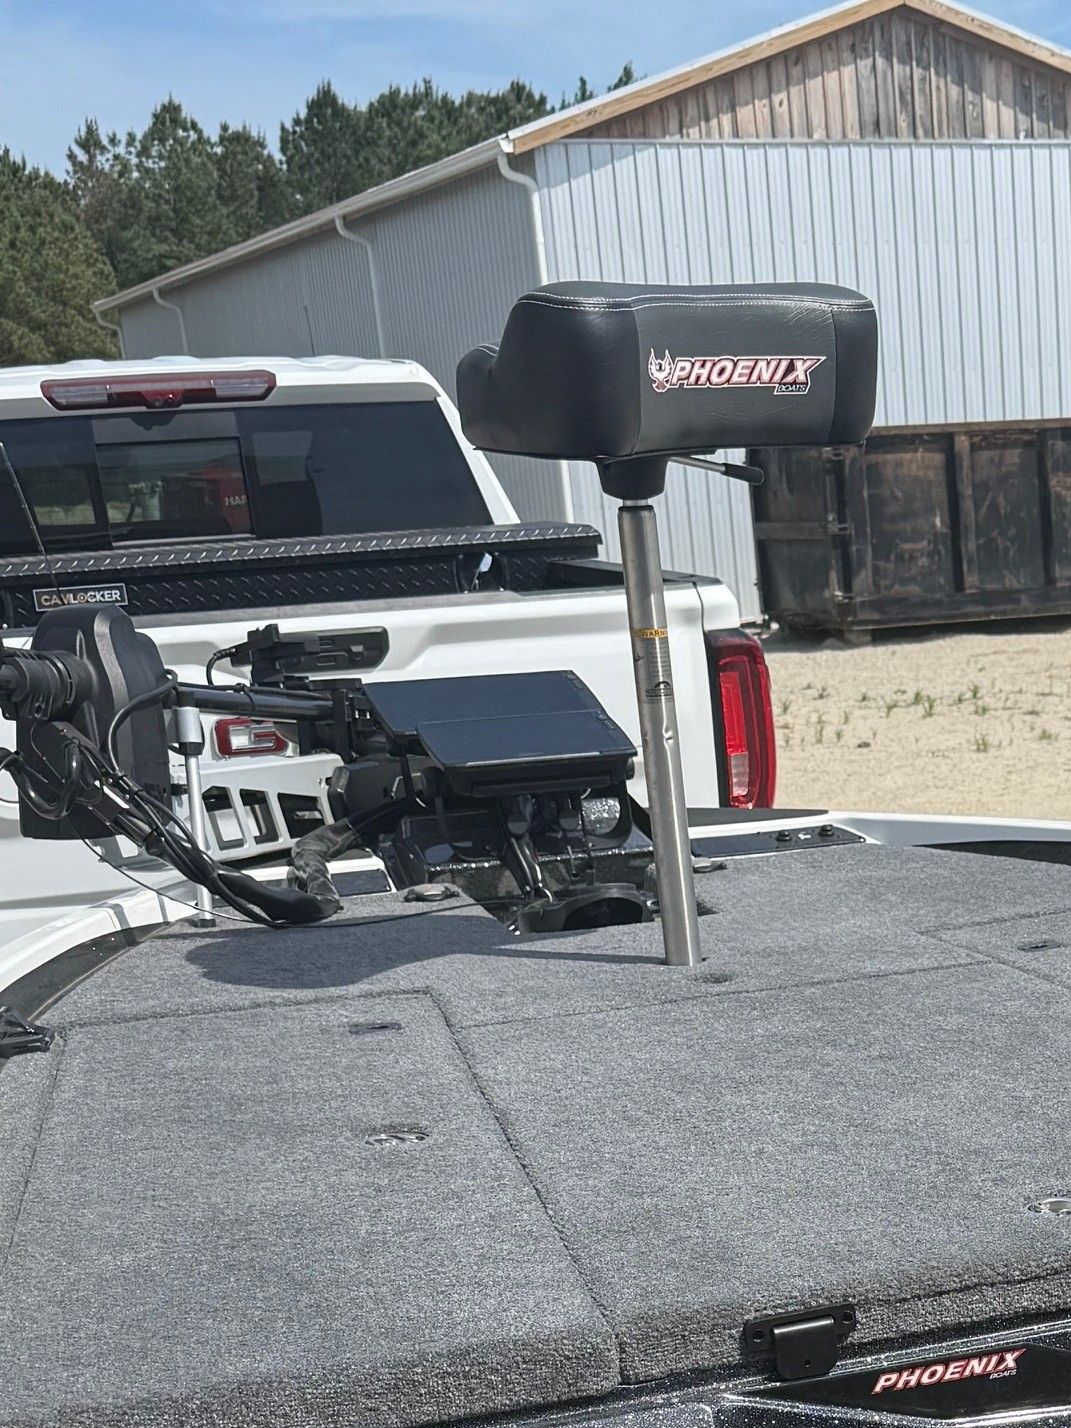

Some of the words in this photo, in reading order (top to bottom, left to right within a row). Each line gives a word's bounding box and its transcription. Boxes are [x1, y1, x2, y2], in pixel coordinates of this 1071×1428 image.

[671, 357, 825, 387] PHOENIX
[778, 384, 806, 392] BOATS
[871, 1349, 1026, 1395] PHOENIX
[989, 1369, 1017, 1380] BOATS
